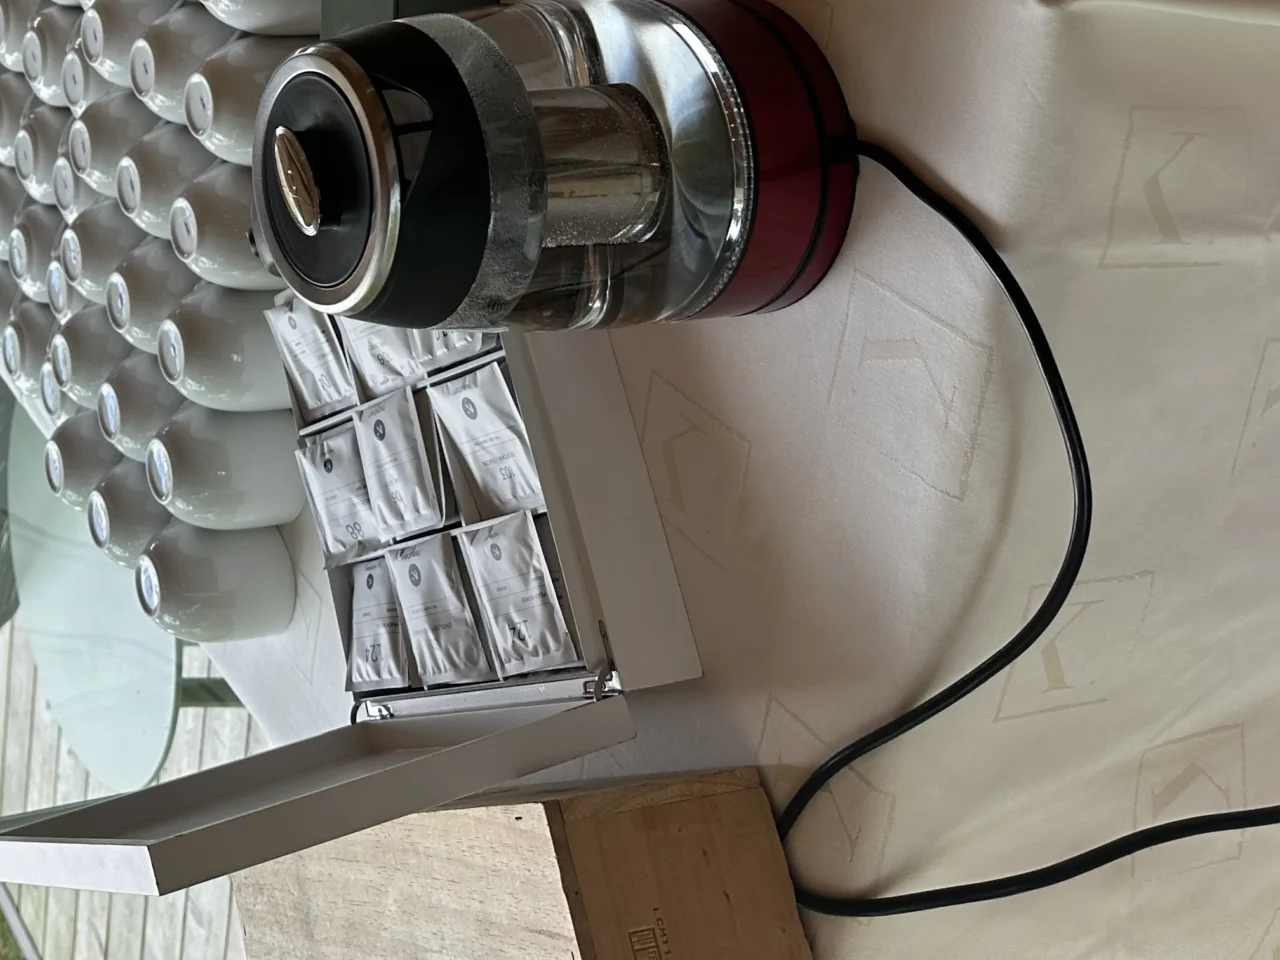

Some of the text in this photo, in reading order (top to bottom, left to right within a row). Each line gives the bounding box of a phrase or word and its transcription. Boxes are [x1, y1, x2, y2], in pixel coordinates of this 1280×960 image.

[500, 466, 516, 480] 103
[346, 522, 364, 540] 88
[509, 620, 531, 642] 124
[365, 643, 383, 664] 124
